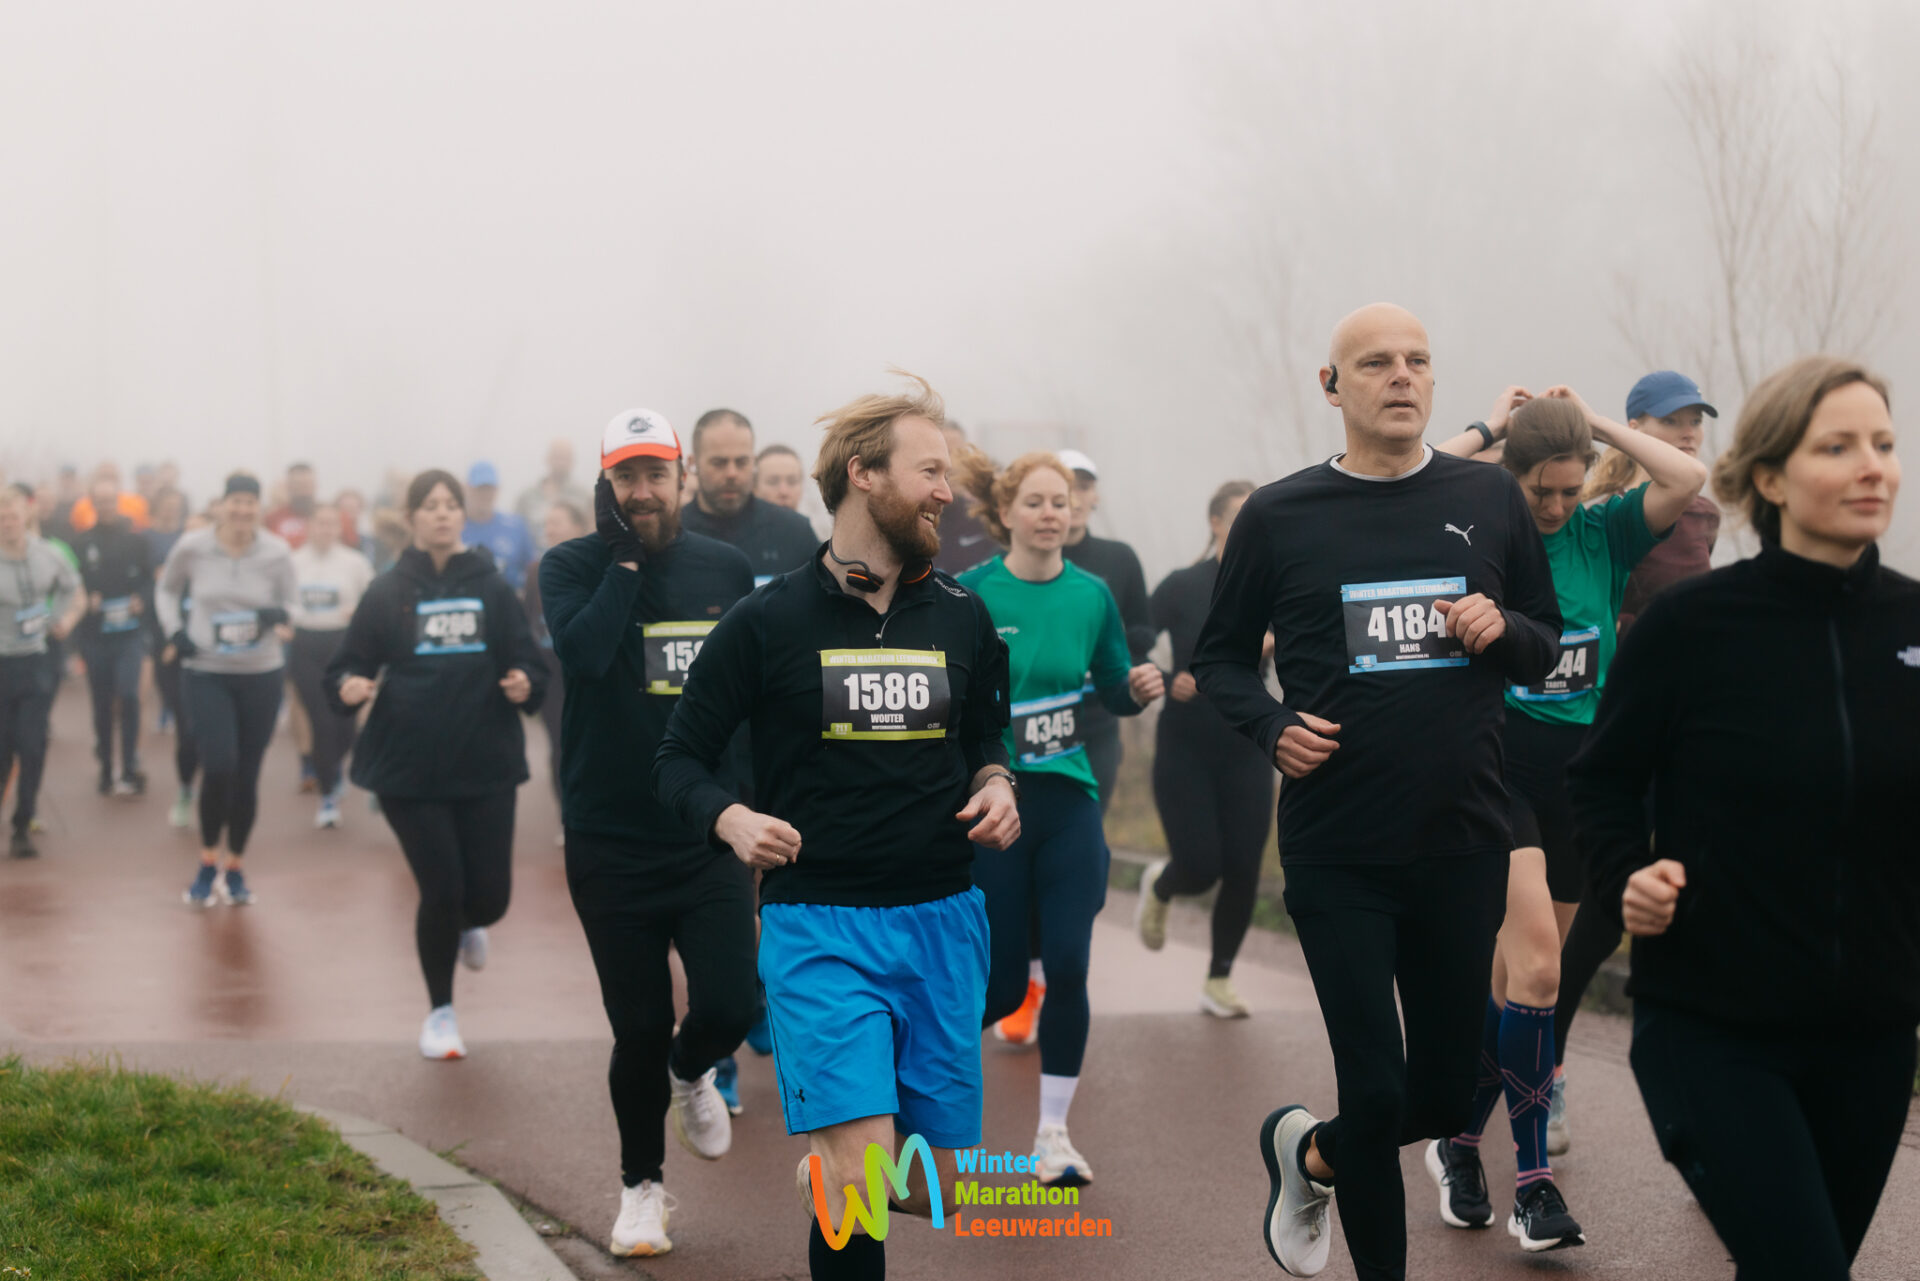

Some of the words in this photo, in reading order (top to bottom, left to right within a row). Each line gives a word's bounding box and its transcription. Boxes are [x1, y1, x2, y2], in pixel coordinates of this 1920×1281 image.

[1367, 603, 1447, 642] 4184
[1399, 643, 1421, 653] HANS
[1545, 647, 1587, 679] 44
[843, 672, 930, 711] 1586
[870, 713, 904, 724] WOUTER
[1025, 708, 1075, 744] 4345
